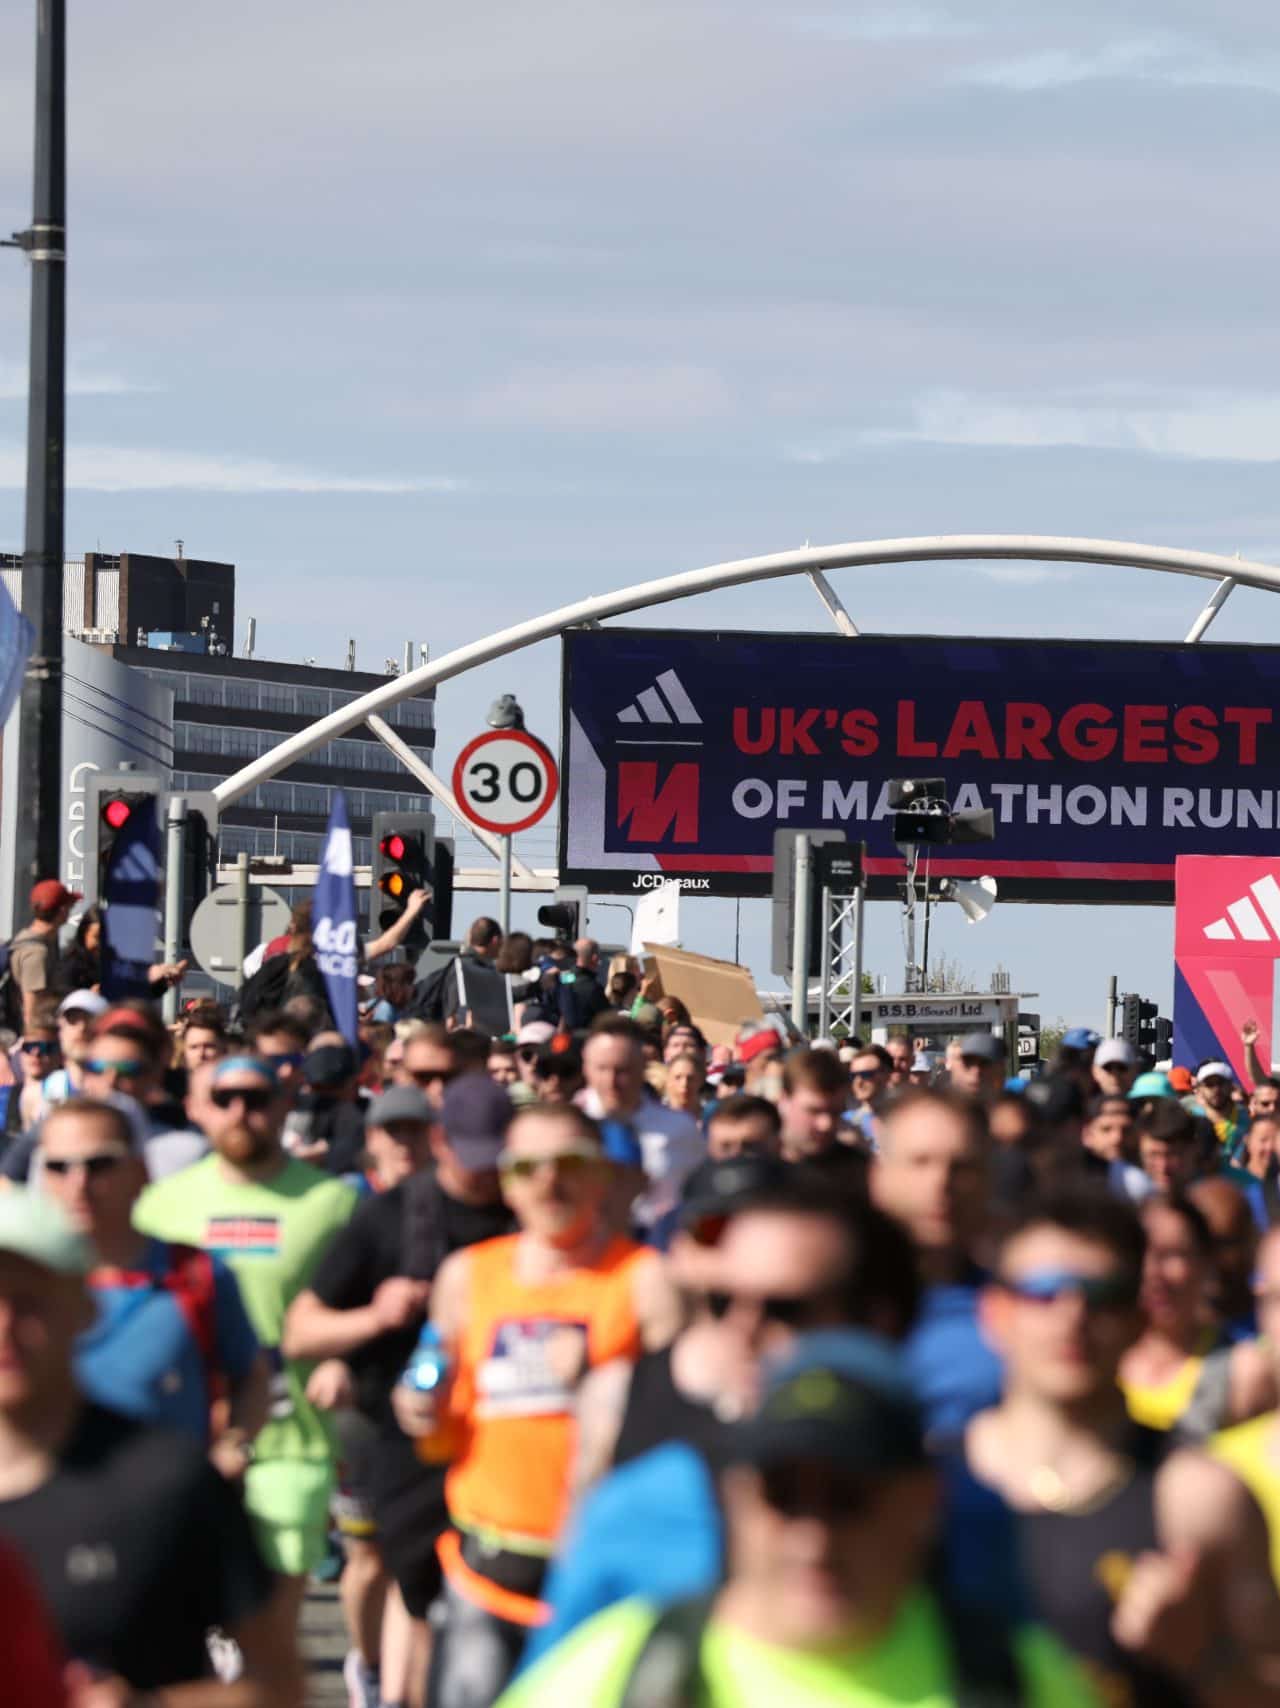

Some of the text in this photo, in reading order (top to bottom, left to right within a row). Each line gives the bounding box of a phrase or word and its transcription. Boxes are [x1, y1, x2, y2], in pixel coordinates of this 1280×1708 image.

[896, 700, 1273, 765] LARGEST
[469, 762, 542, 804] 30
[731, 778, 808, 819] OF
[822, 780, 1148, 826] MAATHON
